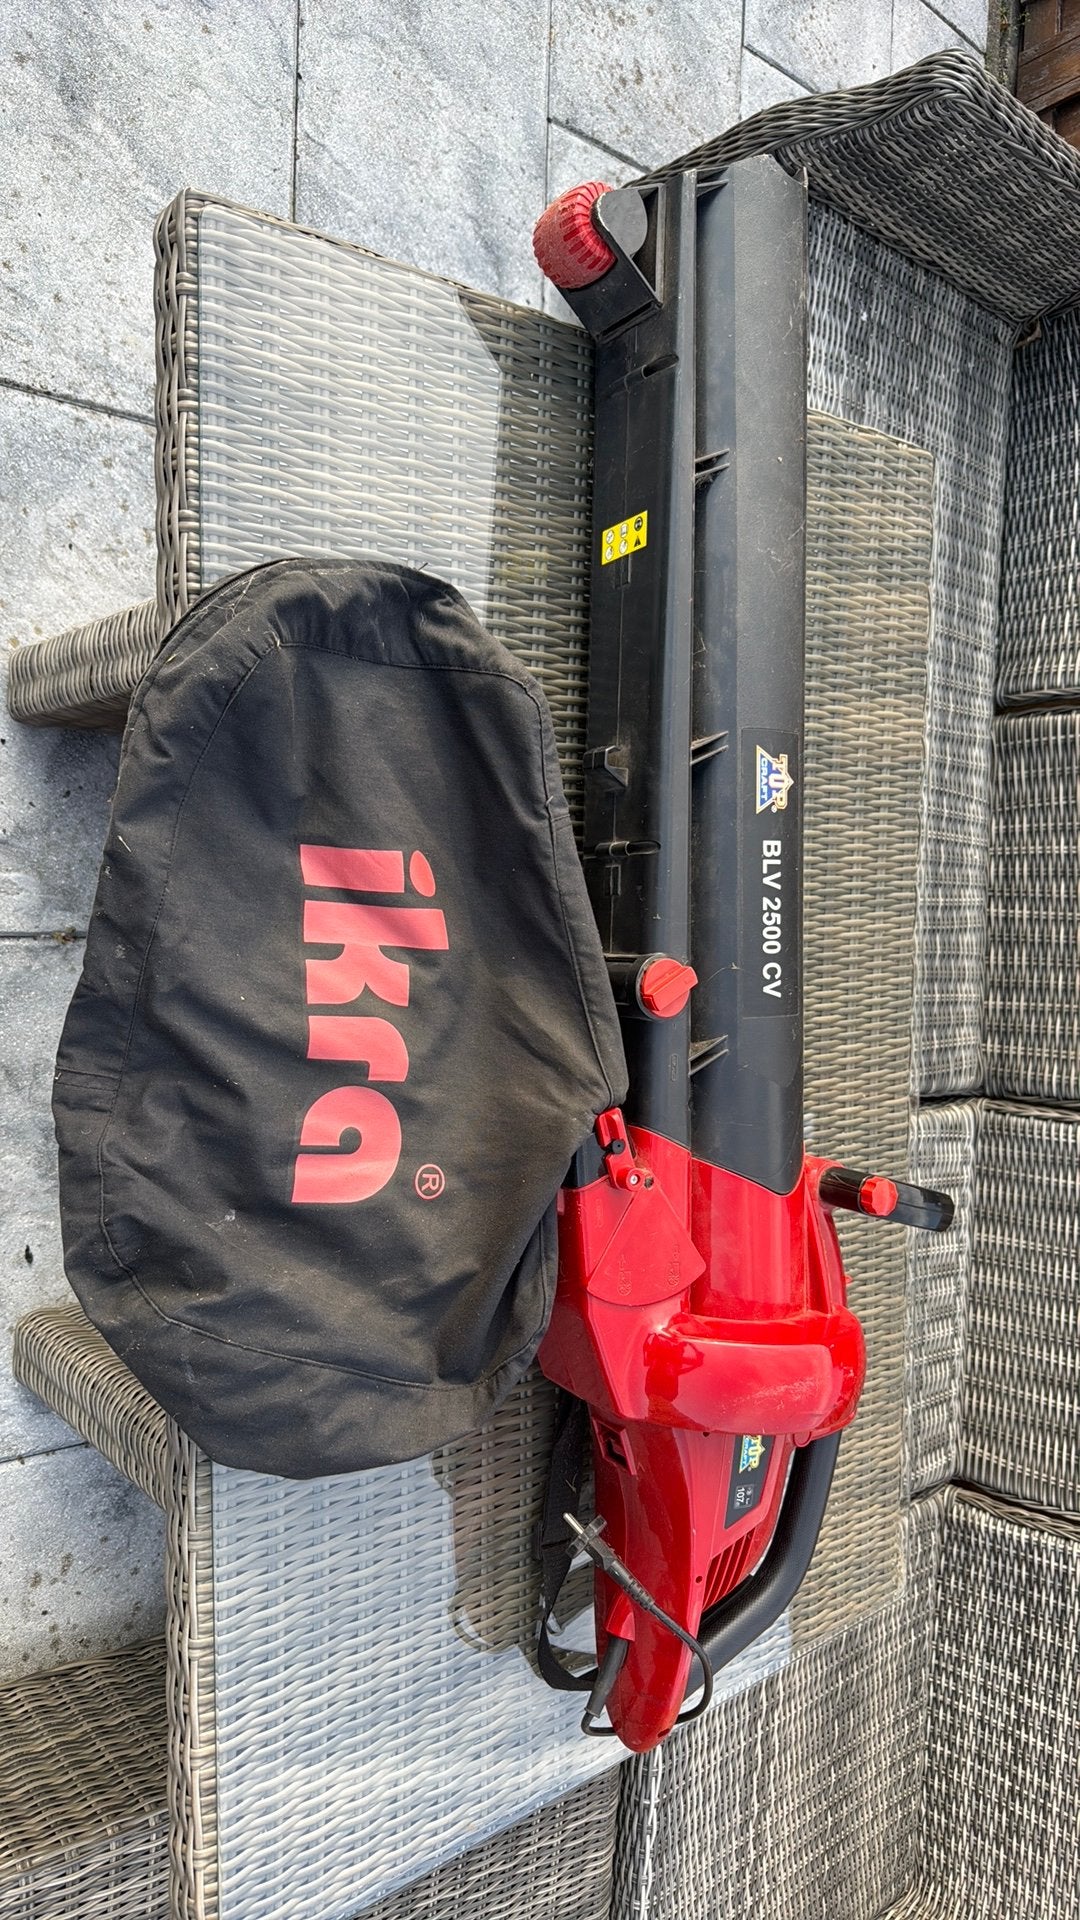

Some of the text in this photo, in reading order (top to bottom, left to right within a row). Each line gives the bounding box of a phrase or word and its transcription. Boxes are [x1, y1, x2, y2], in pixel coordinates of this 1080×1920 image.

[760, 757, 768, 801] CRAFT
[768, 753, 790, 809] TOP
[762, 840, 782, 998] BLV 2500 CV
[291, 844, 449, 1203] ikra
[736, 1487, 746, 1503] 107
